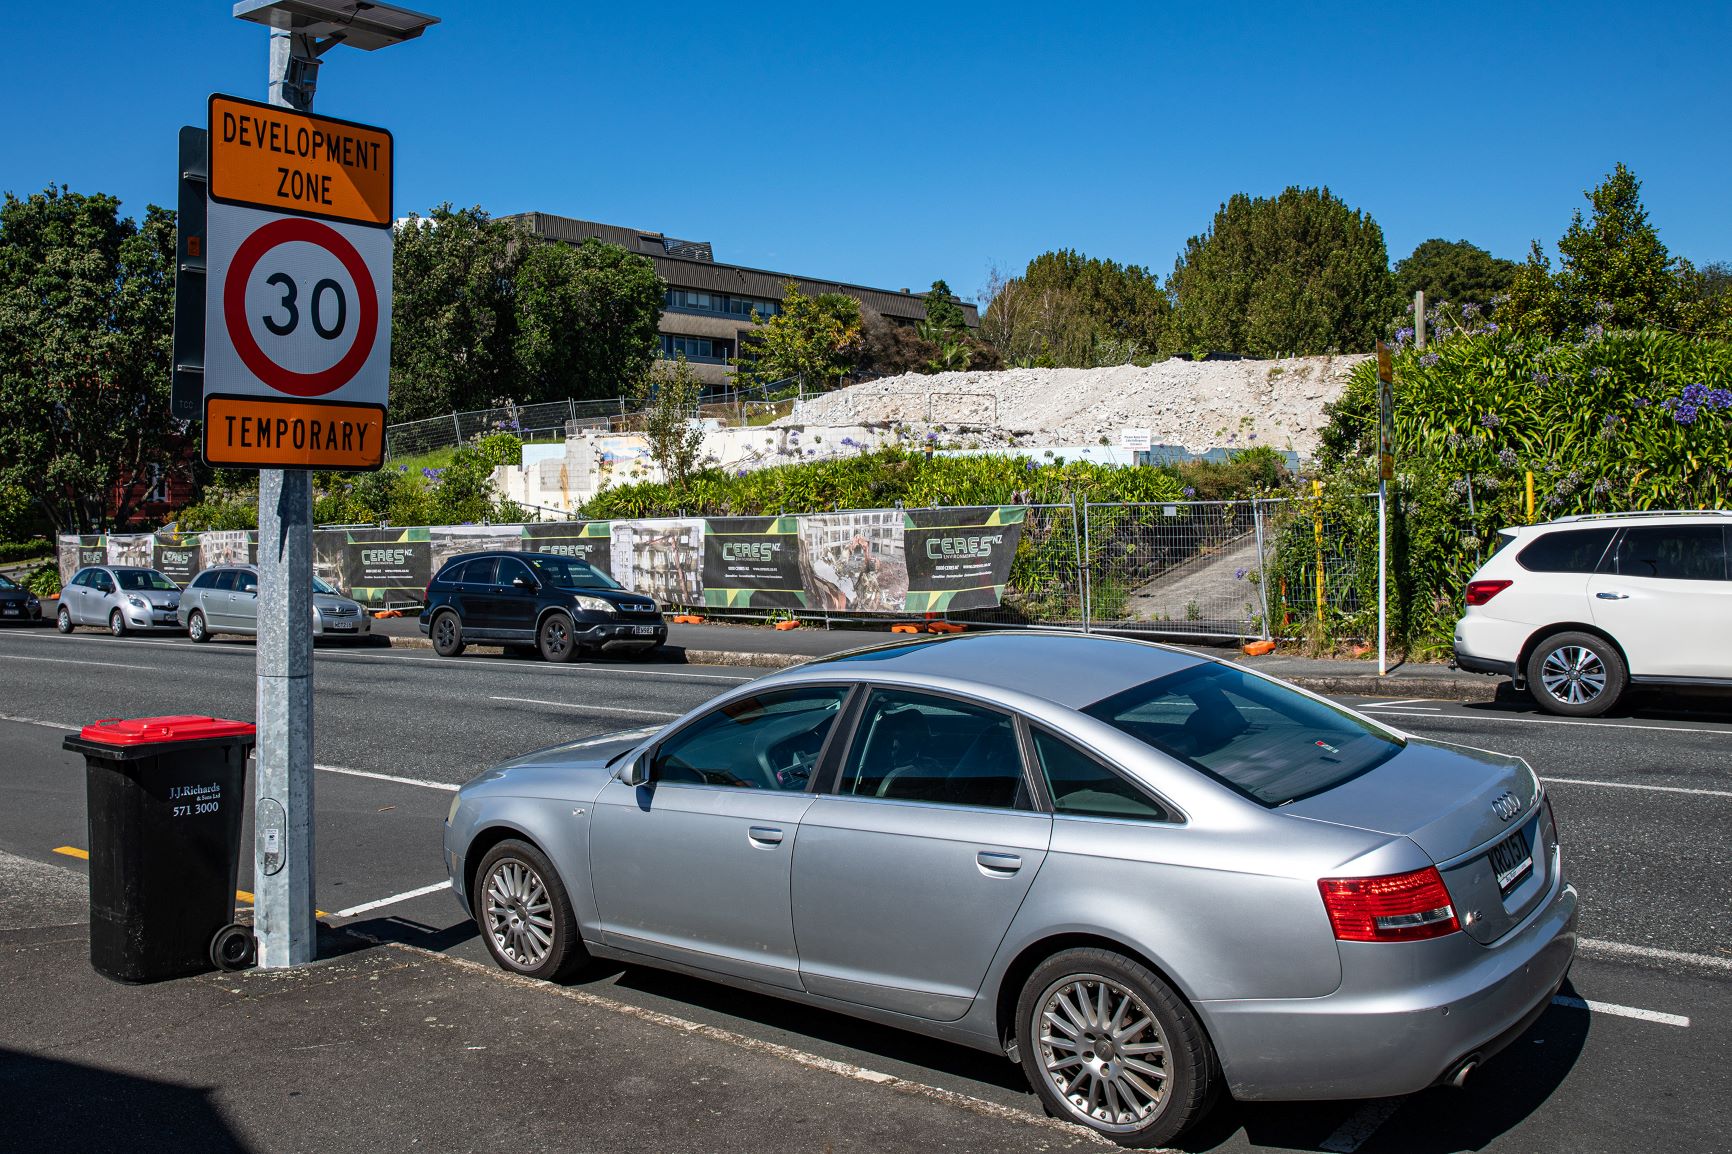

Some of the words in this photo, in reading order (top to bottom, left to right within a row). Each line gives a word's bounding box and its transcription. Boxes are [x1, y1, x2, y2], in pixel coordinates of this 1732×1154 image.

[223, 112, 381, 171] DEVELOPMENT
[277, 167, 333, 206] ZONE
[262, 272, 347, 340] 30
[225, 415, 369, 452] TEMPORARY
[361, 549, 405, 565] CERES
[585, 545, 593, 553] NZ
[722, 543, 772, 562] CERES
[771, 543, 781, 551] NZ
[926, 536, 992, 559] CERES
[992, 535, 1003, 544] NZ
[169, 782, 220, 800] J.J.Richards
[173, 805, 191, 817] 571
[195, 801, 219, 814] 3000
